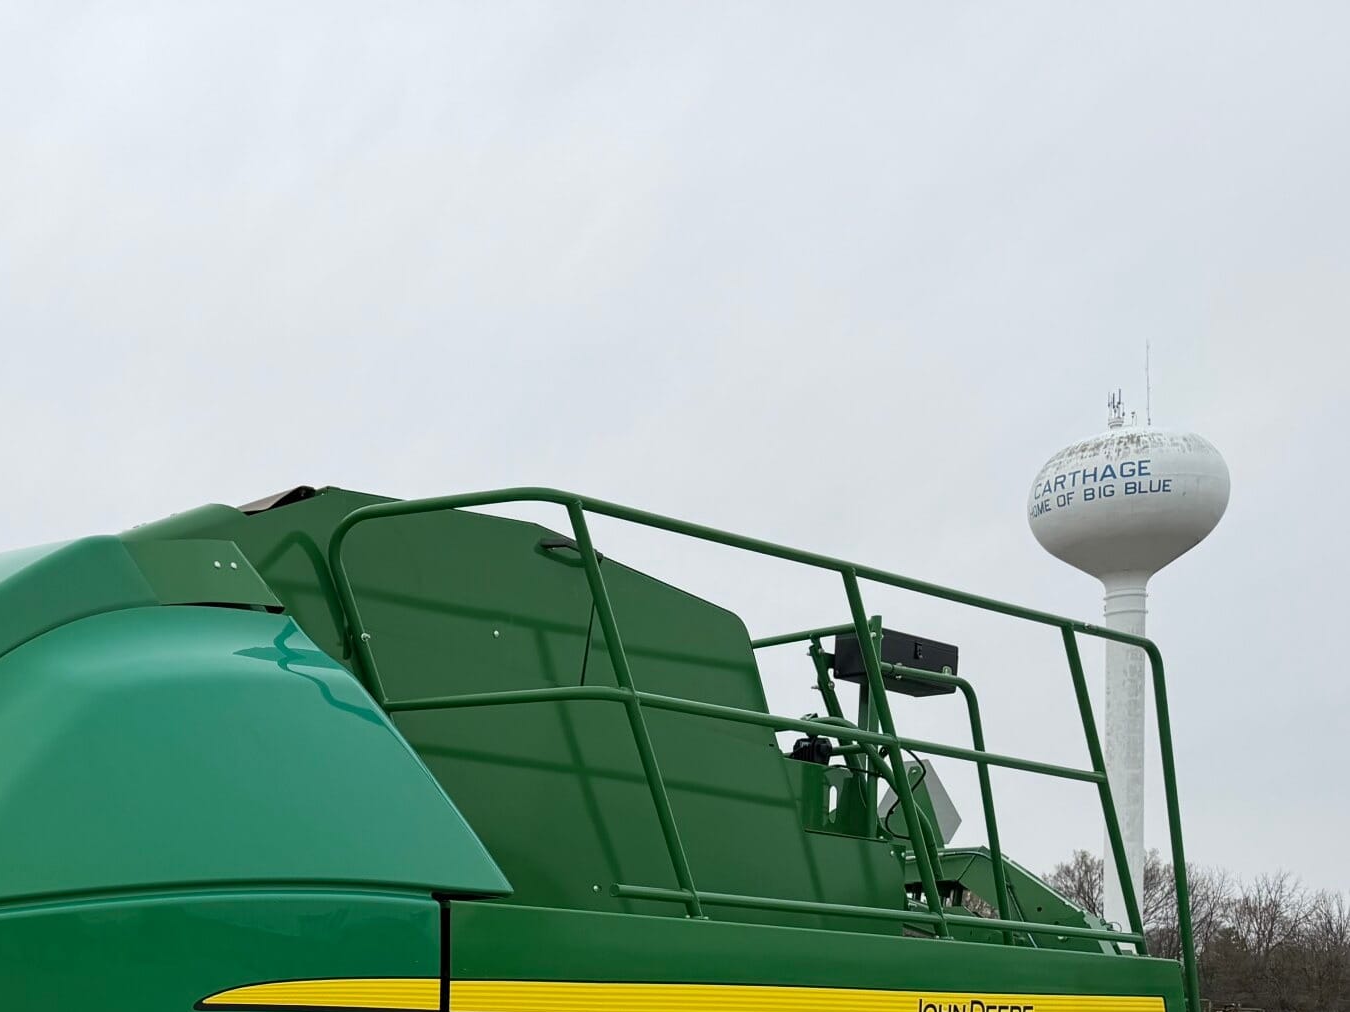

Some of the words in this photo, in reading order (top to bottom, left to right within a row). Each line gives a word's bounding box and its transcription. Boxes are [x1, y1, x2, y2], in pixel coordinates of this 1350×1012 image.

[1034, 460, 1151, 500] CARTHAGE
[1056, 491, 1075, 508] OF
[1083, 484, 1115, 501] BIG
[1124, 479, 1173, 496] BLUE
